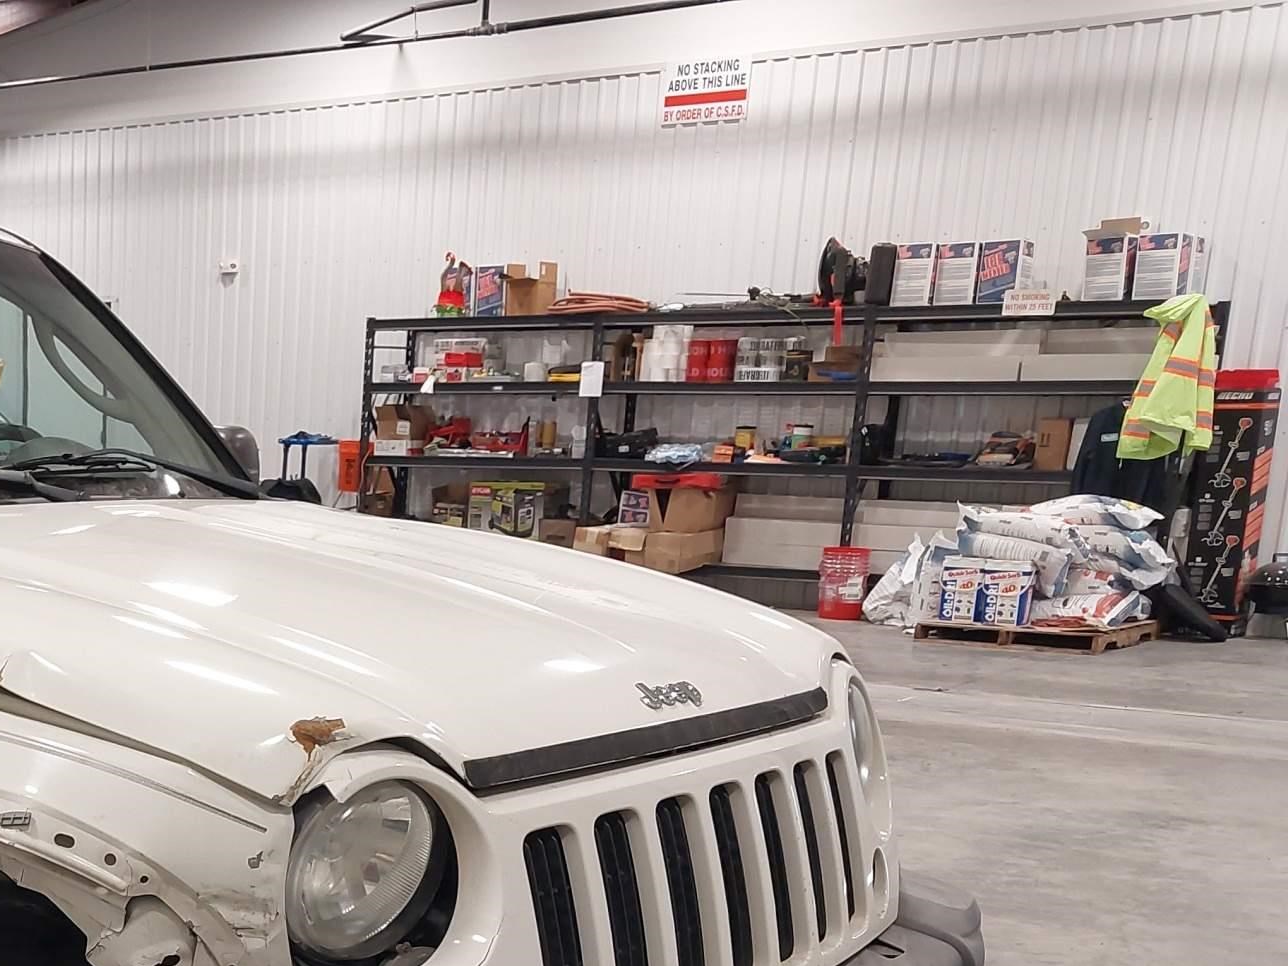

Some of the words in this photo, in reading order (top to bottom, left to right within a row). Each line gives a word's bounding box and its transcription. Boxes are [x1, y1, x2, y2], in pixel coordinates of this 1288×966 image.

[677, 64, 690, 76] NO
[693, 59, 740, 75] STACKING
[668, 78, 699, 92] ABOVE
[702, 75, 723, 89] THIS
[725, 73, 747, 88] LINE
[663, 111, 674, 122] BY
[676, 107, 702, 121] ORDER
[704, 107, 715, 119] OF
[716, 104, 745, 118] C.S.F.D.
[1022, 293, 1050, 301] SMOKING
[1005, 303, 1027, 311] WITHIN
[1037, 302, 1054, 310] FEET
[634, 681, 702, 709] Jeep
